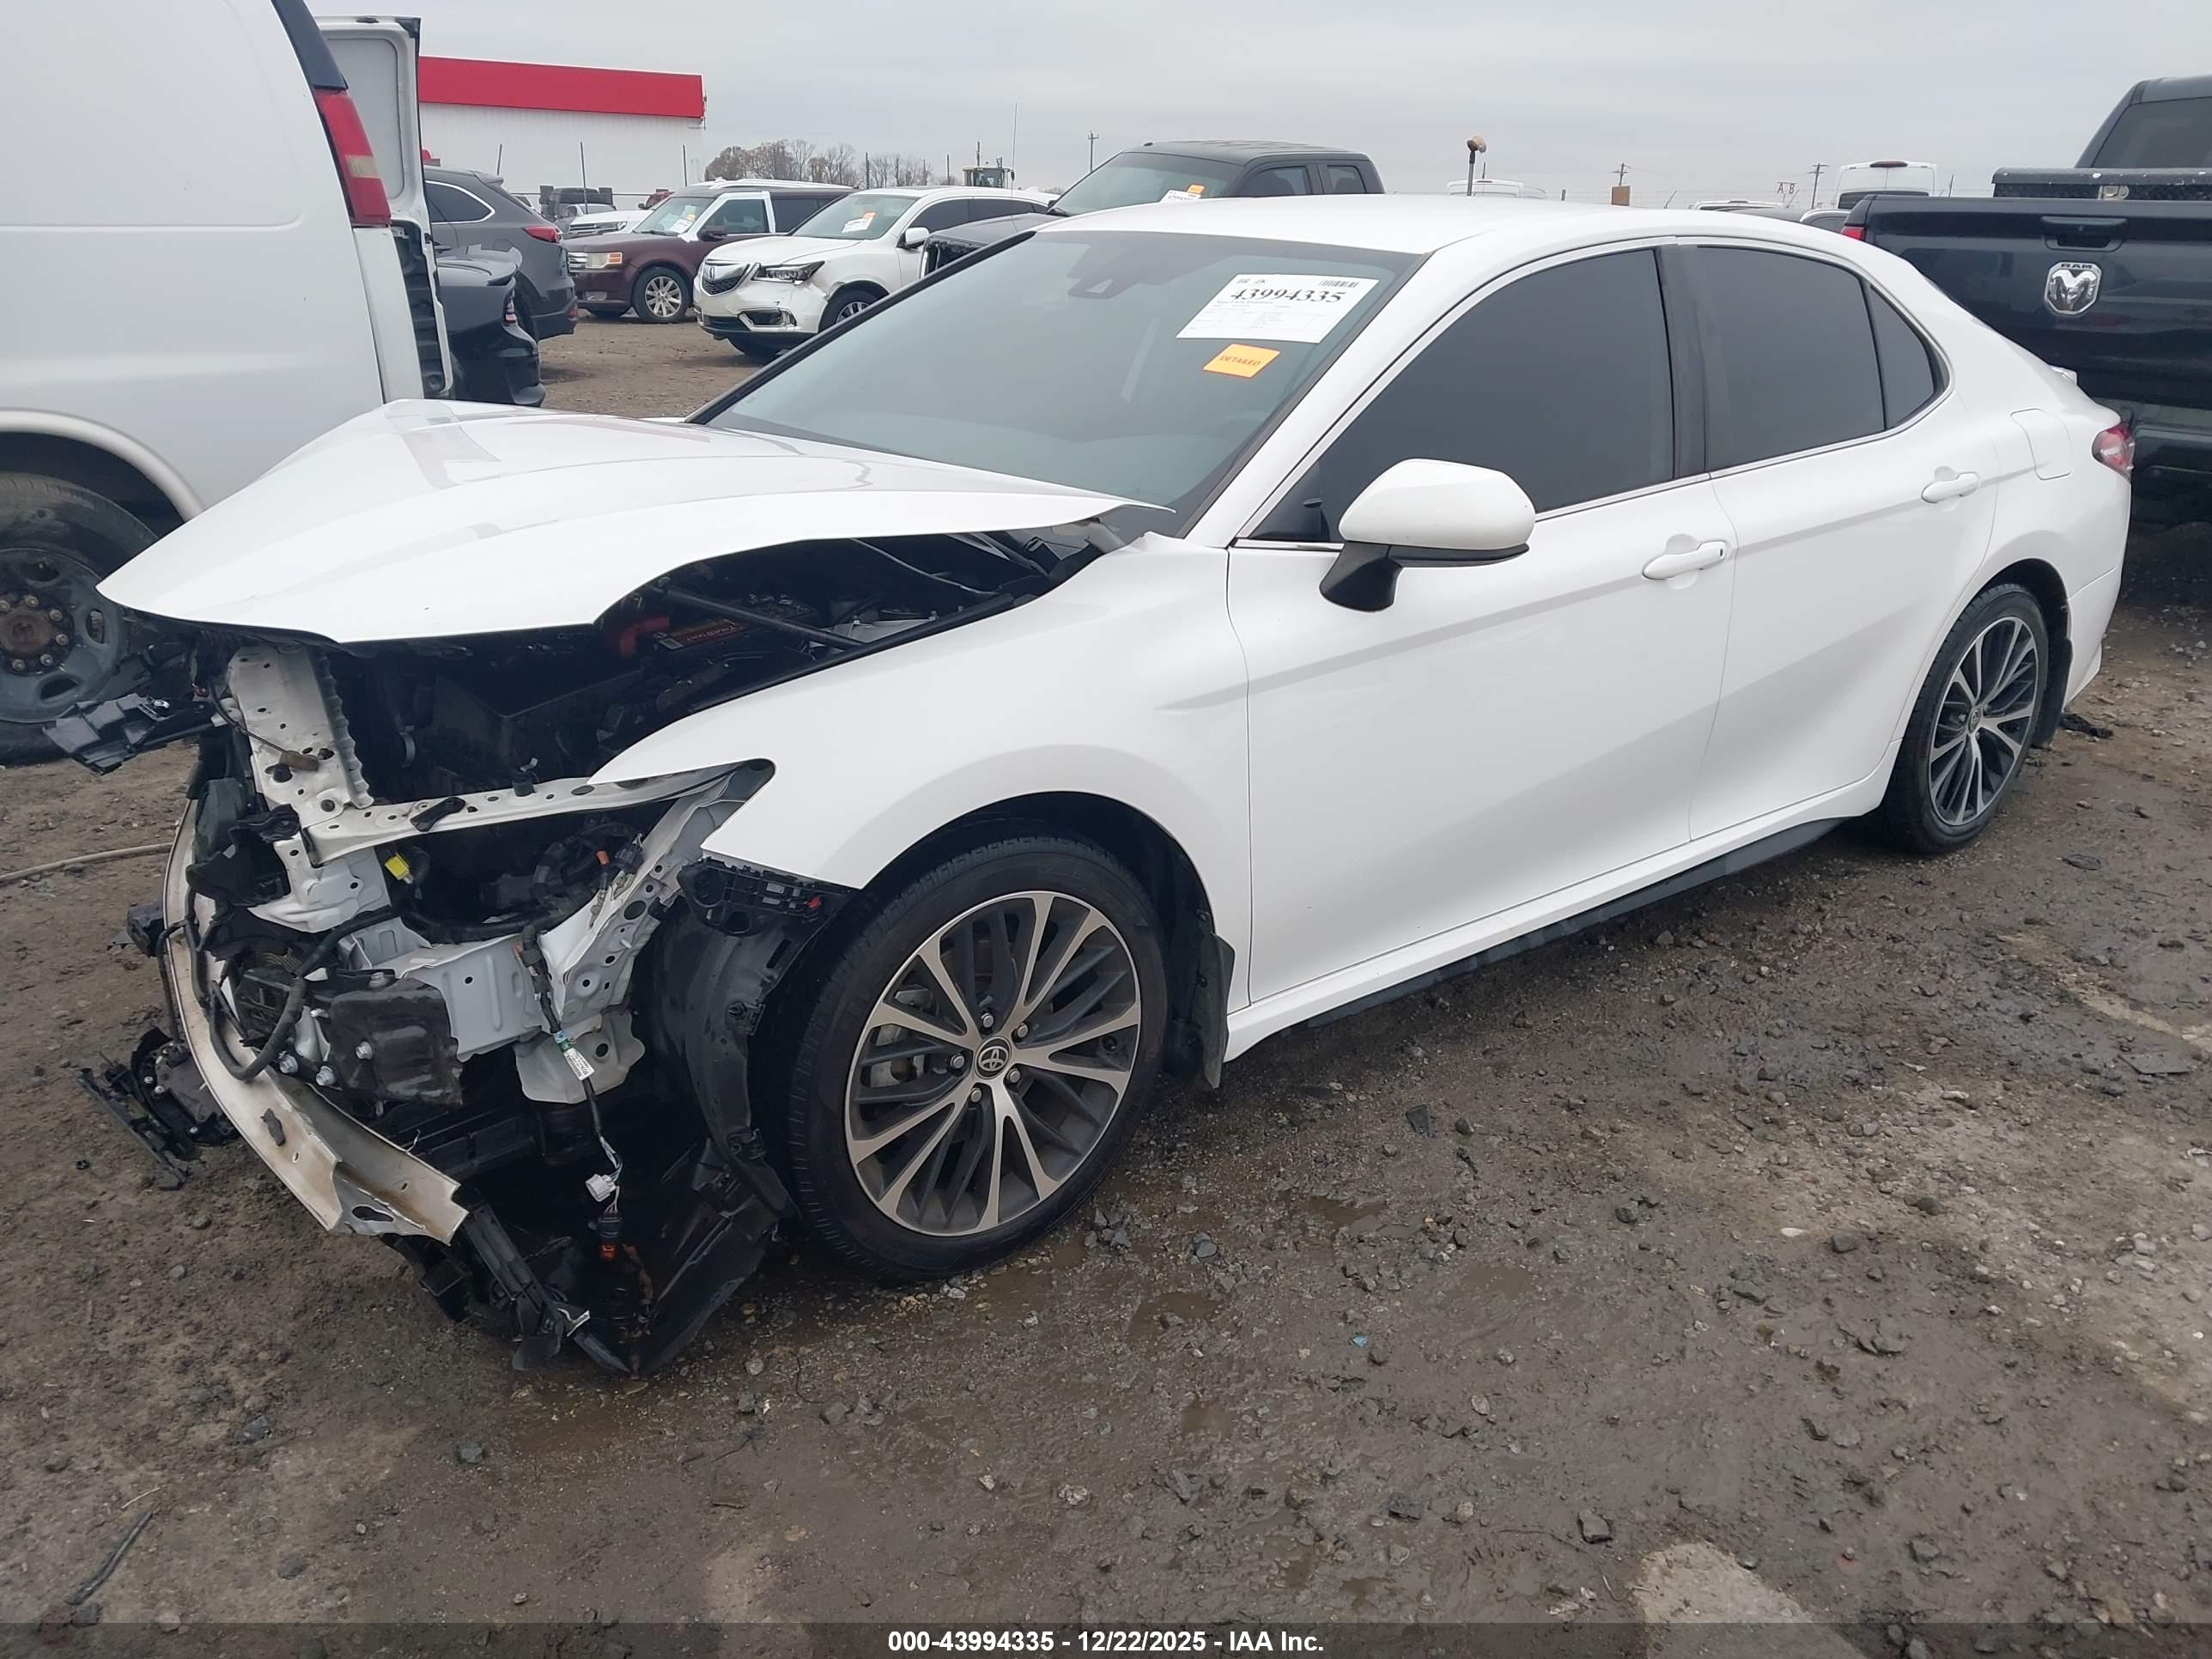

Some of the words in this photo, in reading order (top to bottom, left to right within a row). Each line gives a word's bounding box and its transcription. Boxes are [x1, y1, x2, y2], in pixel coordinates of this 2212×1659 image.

[1777, 183, 1784, 193] A
[1789, 183, 1795, 194] B
[1231, 288, 1346, 303] 43994335
[1219, 355, 1261, 366] DETAILED
